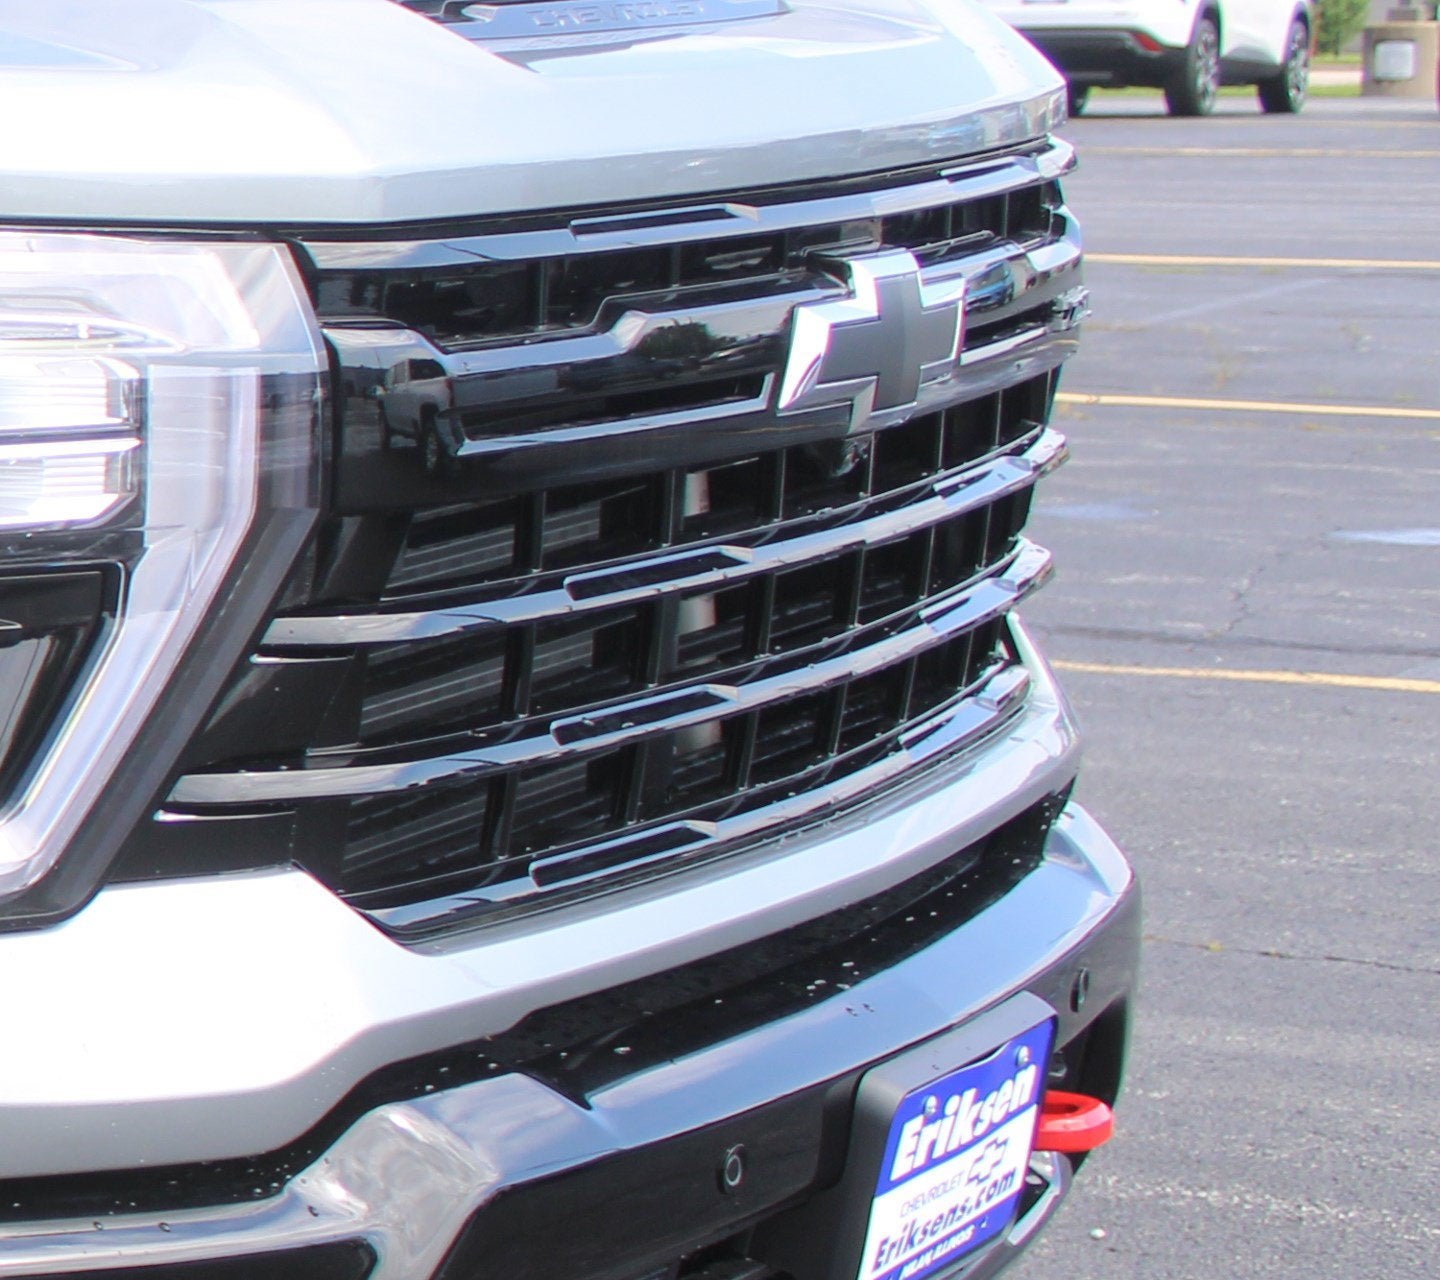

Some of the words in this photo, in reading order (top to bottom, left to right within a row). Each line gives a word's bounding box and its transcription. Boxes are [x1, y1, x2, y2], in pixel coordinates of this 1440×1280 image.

[889, 1063, 1038, 1183] Eriksen
[871, 1168, 1016, 1273] Eriksens.com
[899, 1169, 967, 1219] CHEVROLET
